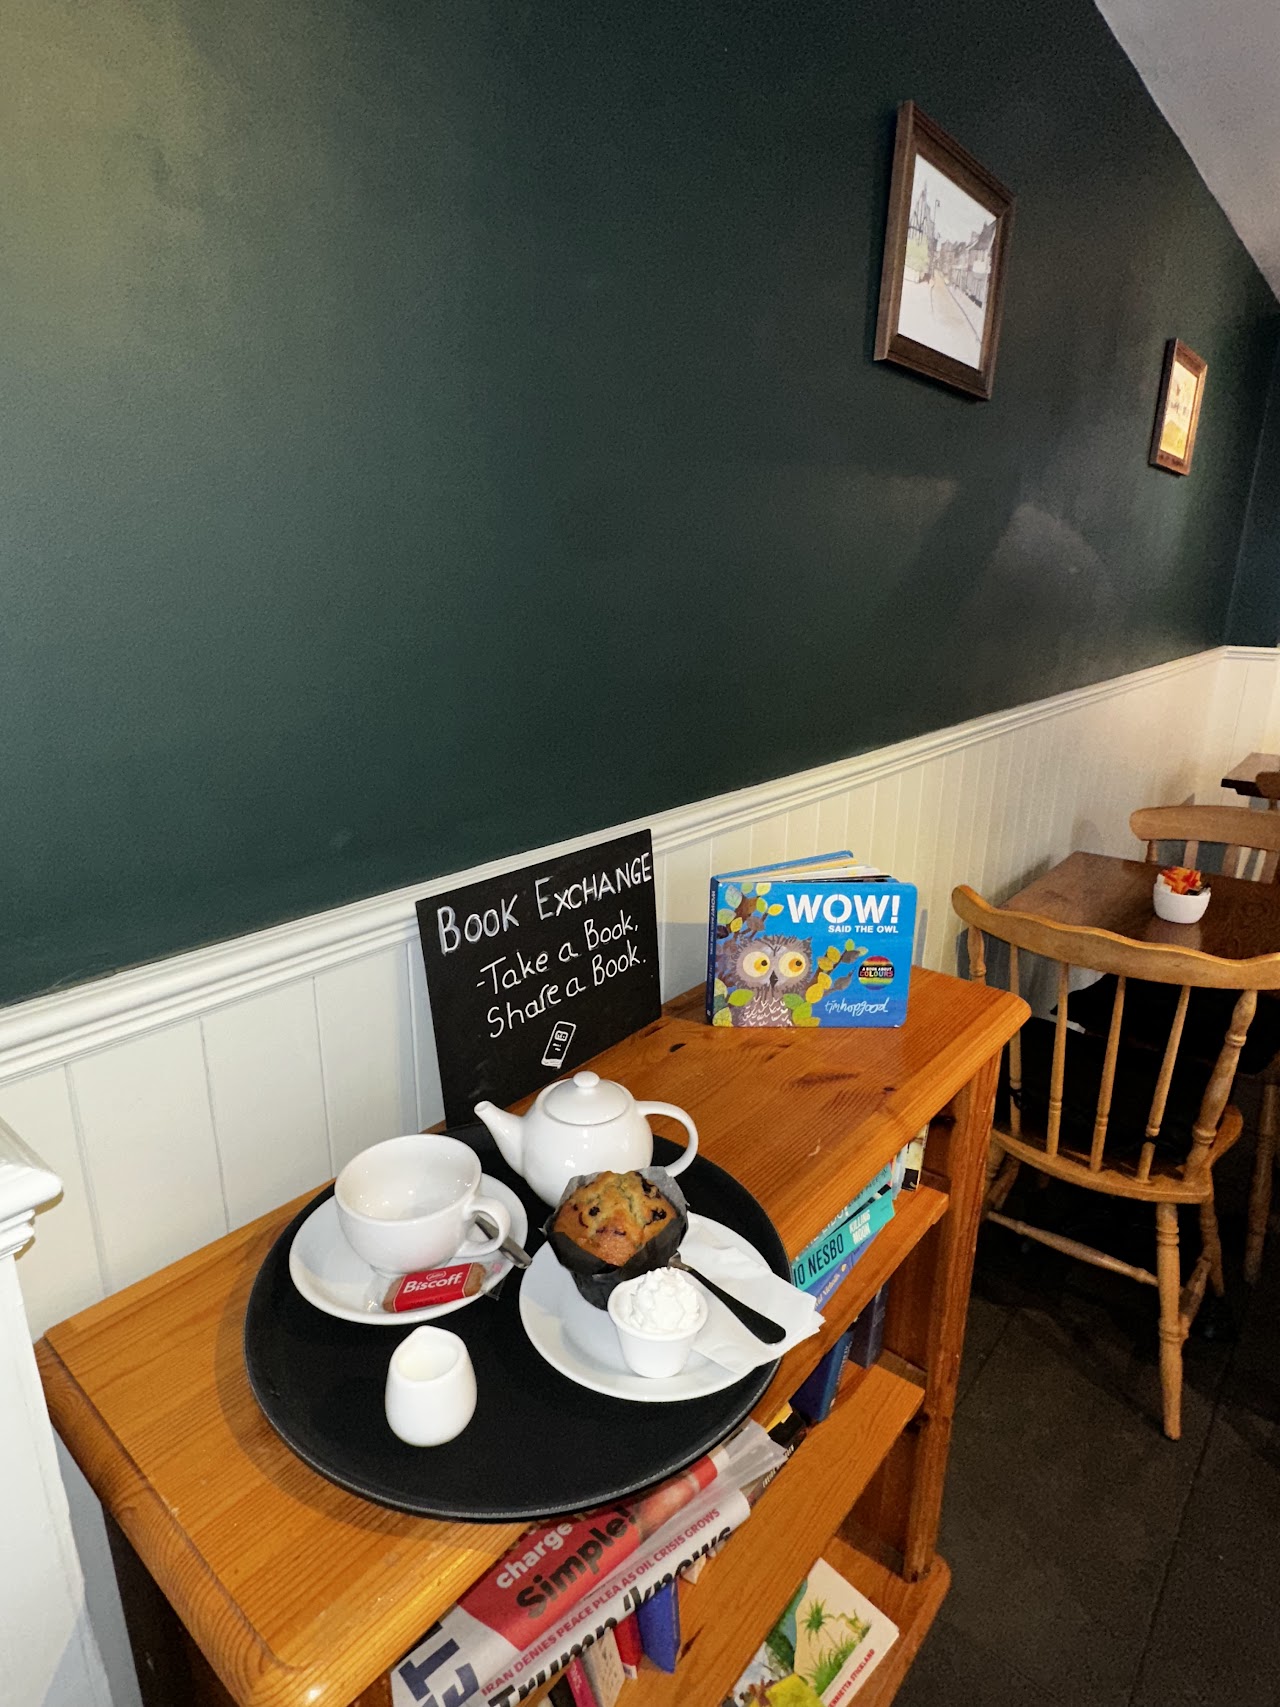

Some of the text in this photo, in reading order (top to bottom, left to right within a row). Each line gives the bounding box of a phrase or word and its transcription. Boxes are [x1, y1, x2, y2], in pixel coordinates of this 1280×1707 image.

[437, 852, 652, 955] BOOK EXCHANGE
[787, 894, 900, 924] WOW!
[828, 925, 899, 934] SAID THE OWL
[558, 942, 579, 963] a
[487, 939, 646, 1038] Share a Book.
[403, 1272, 463, 1294] Biscoff
[808, 1233, 844, 1278] NESBO
[496, 1522, 574, 1589] charge
[516, 1505, 637, 1619] Simple!
[481, 1669, 514, 1696] IRAN
[513, 1635, 557, 1673] DENIES
[556, 1605, 594, 1637] PEACE
[592, 1585, 622, 1610] PLEA
[621, 1572, 637, 1587] AS
[636, 1560, 656, 1577] OIL
[653, 1535, 686, 1562] CRISIS
[684, 1508, 720, 1538] GROWS
